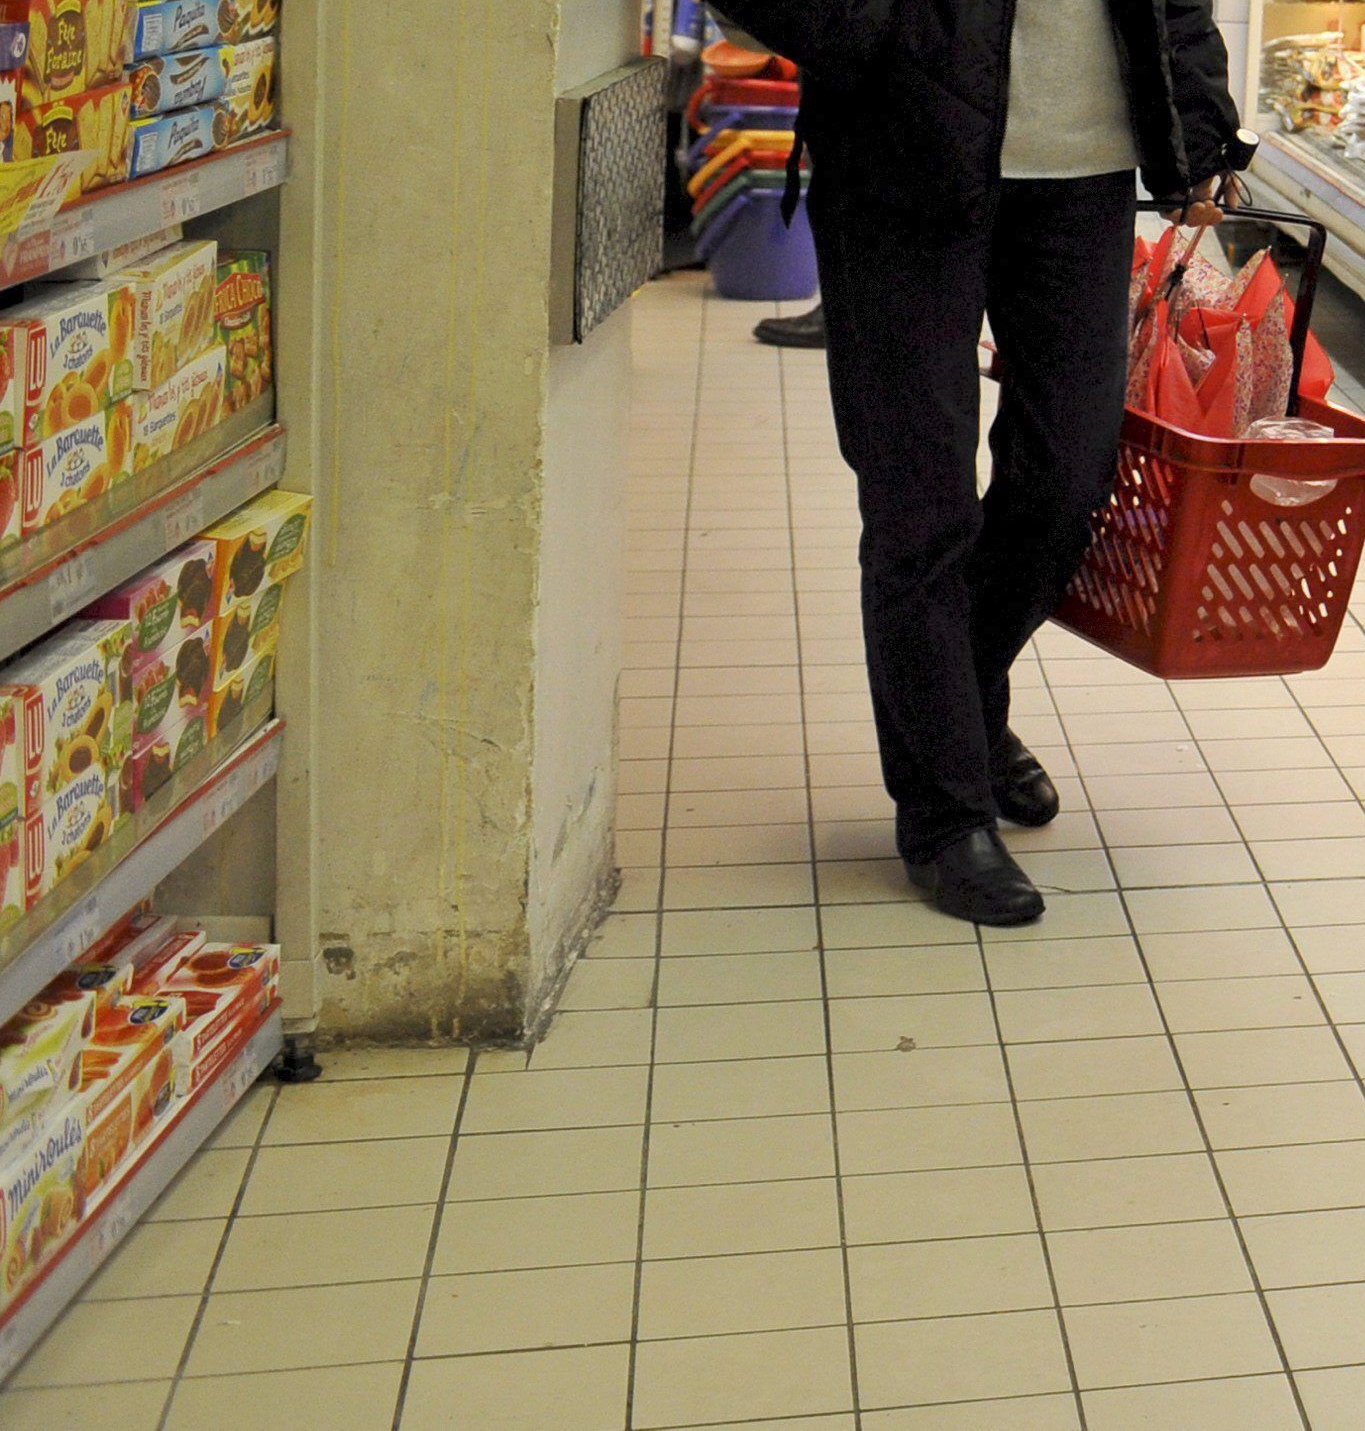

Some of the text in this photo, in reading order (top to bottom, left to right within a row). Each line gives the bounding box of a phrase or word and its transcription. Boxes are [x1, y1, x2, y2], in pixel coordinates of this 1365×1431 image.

[173, 1, 206, 34] Paquita
[168, 116, 201, 150] Paquita
[59, 310, 107, 337] Barquette
[28, 335, 46, 392] LU
[55, 422, 105, 453] Barquette
[27, 456, 43, 513] LU
[56, 659, 105, 699] Barquette
[26, 705, 43, 765] LU
[56, 775, 104, 818] Barquette
[27, 824, 44, 882] LU
[8, 1118, 83, 1222] miniroulés
